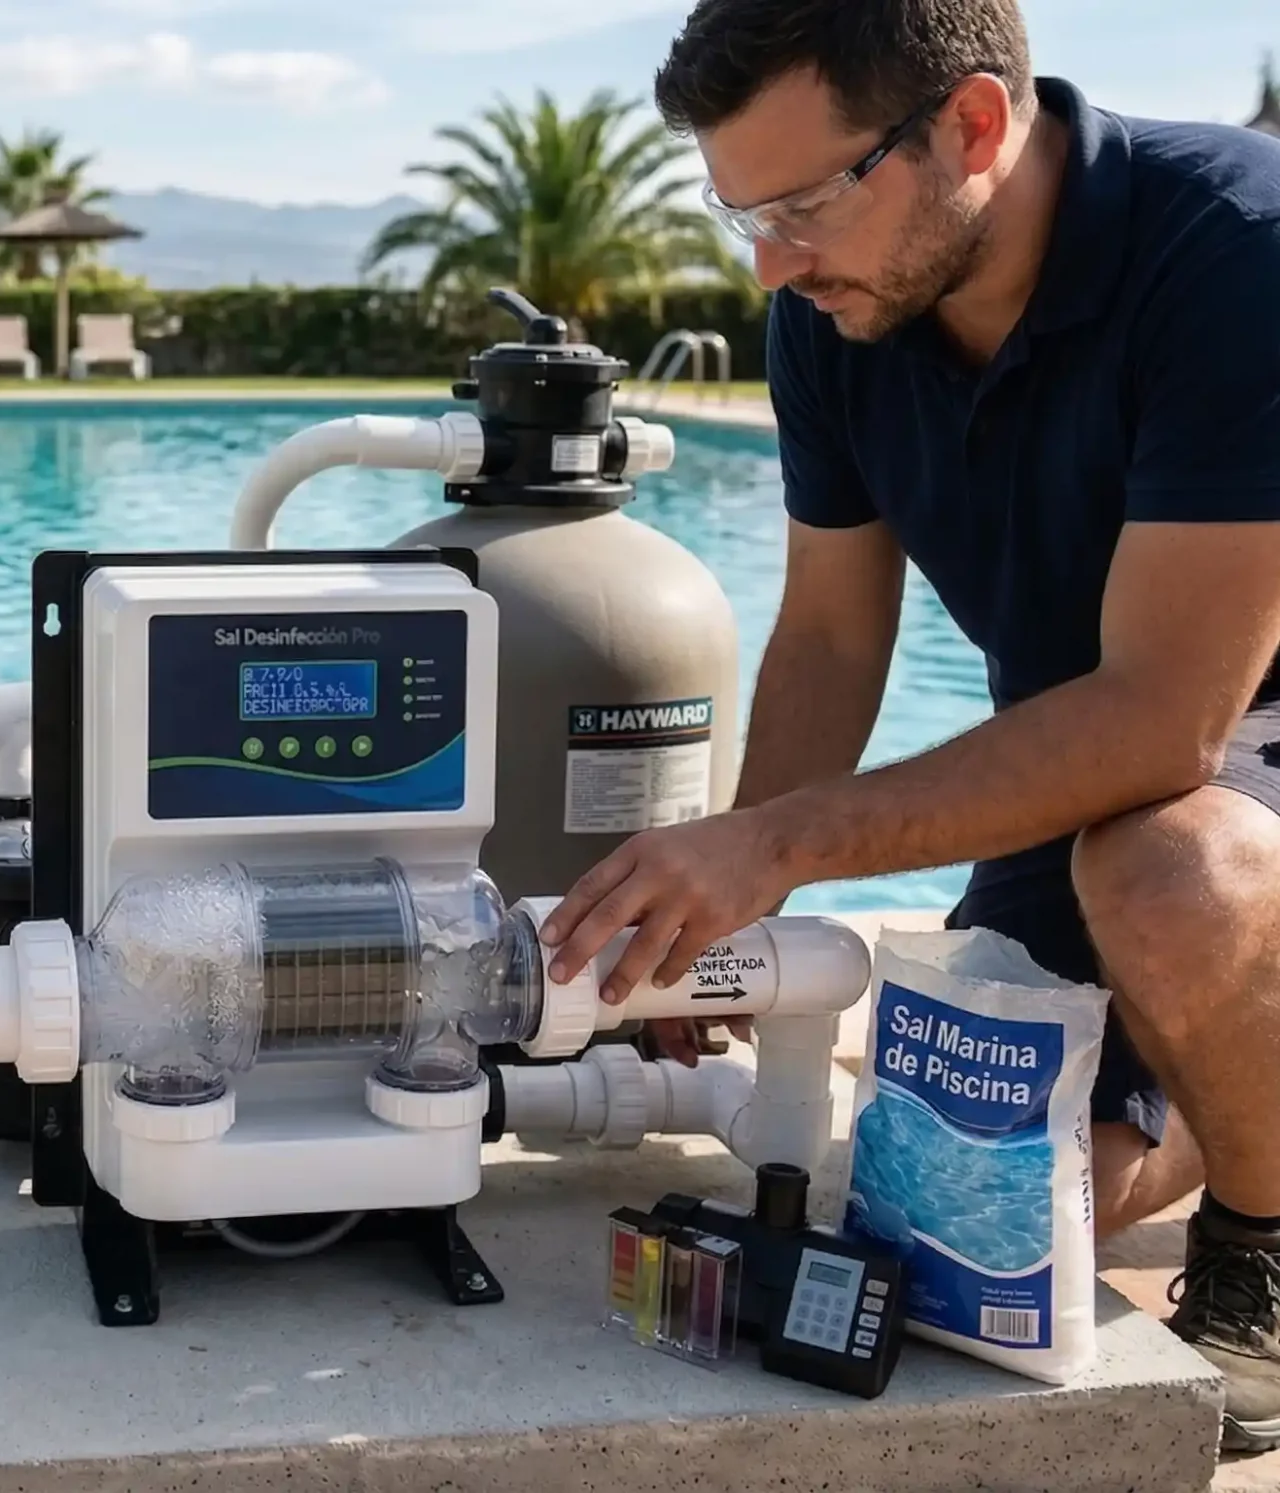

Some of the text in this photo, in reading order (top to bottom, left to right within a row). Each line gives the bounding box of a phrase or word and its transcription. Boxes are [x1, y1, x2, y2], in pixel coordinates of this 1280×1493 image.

[214, 626, 382, 646] Sal Desinfección Pro
[600, 704, 709, 731] HAYWARD
[890, 1004, 1038, 1069] Sal Marina
[884, 1042, 1031, 1105] de Piscina
